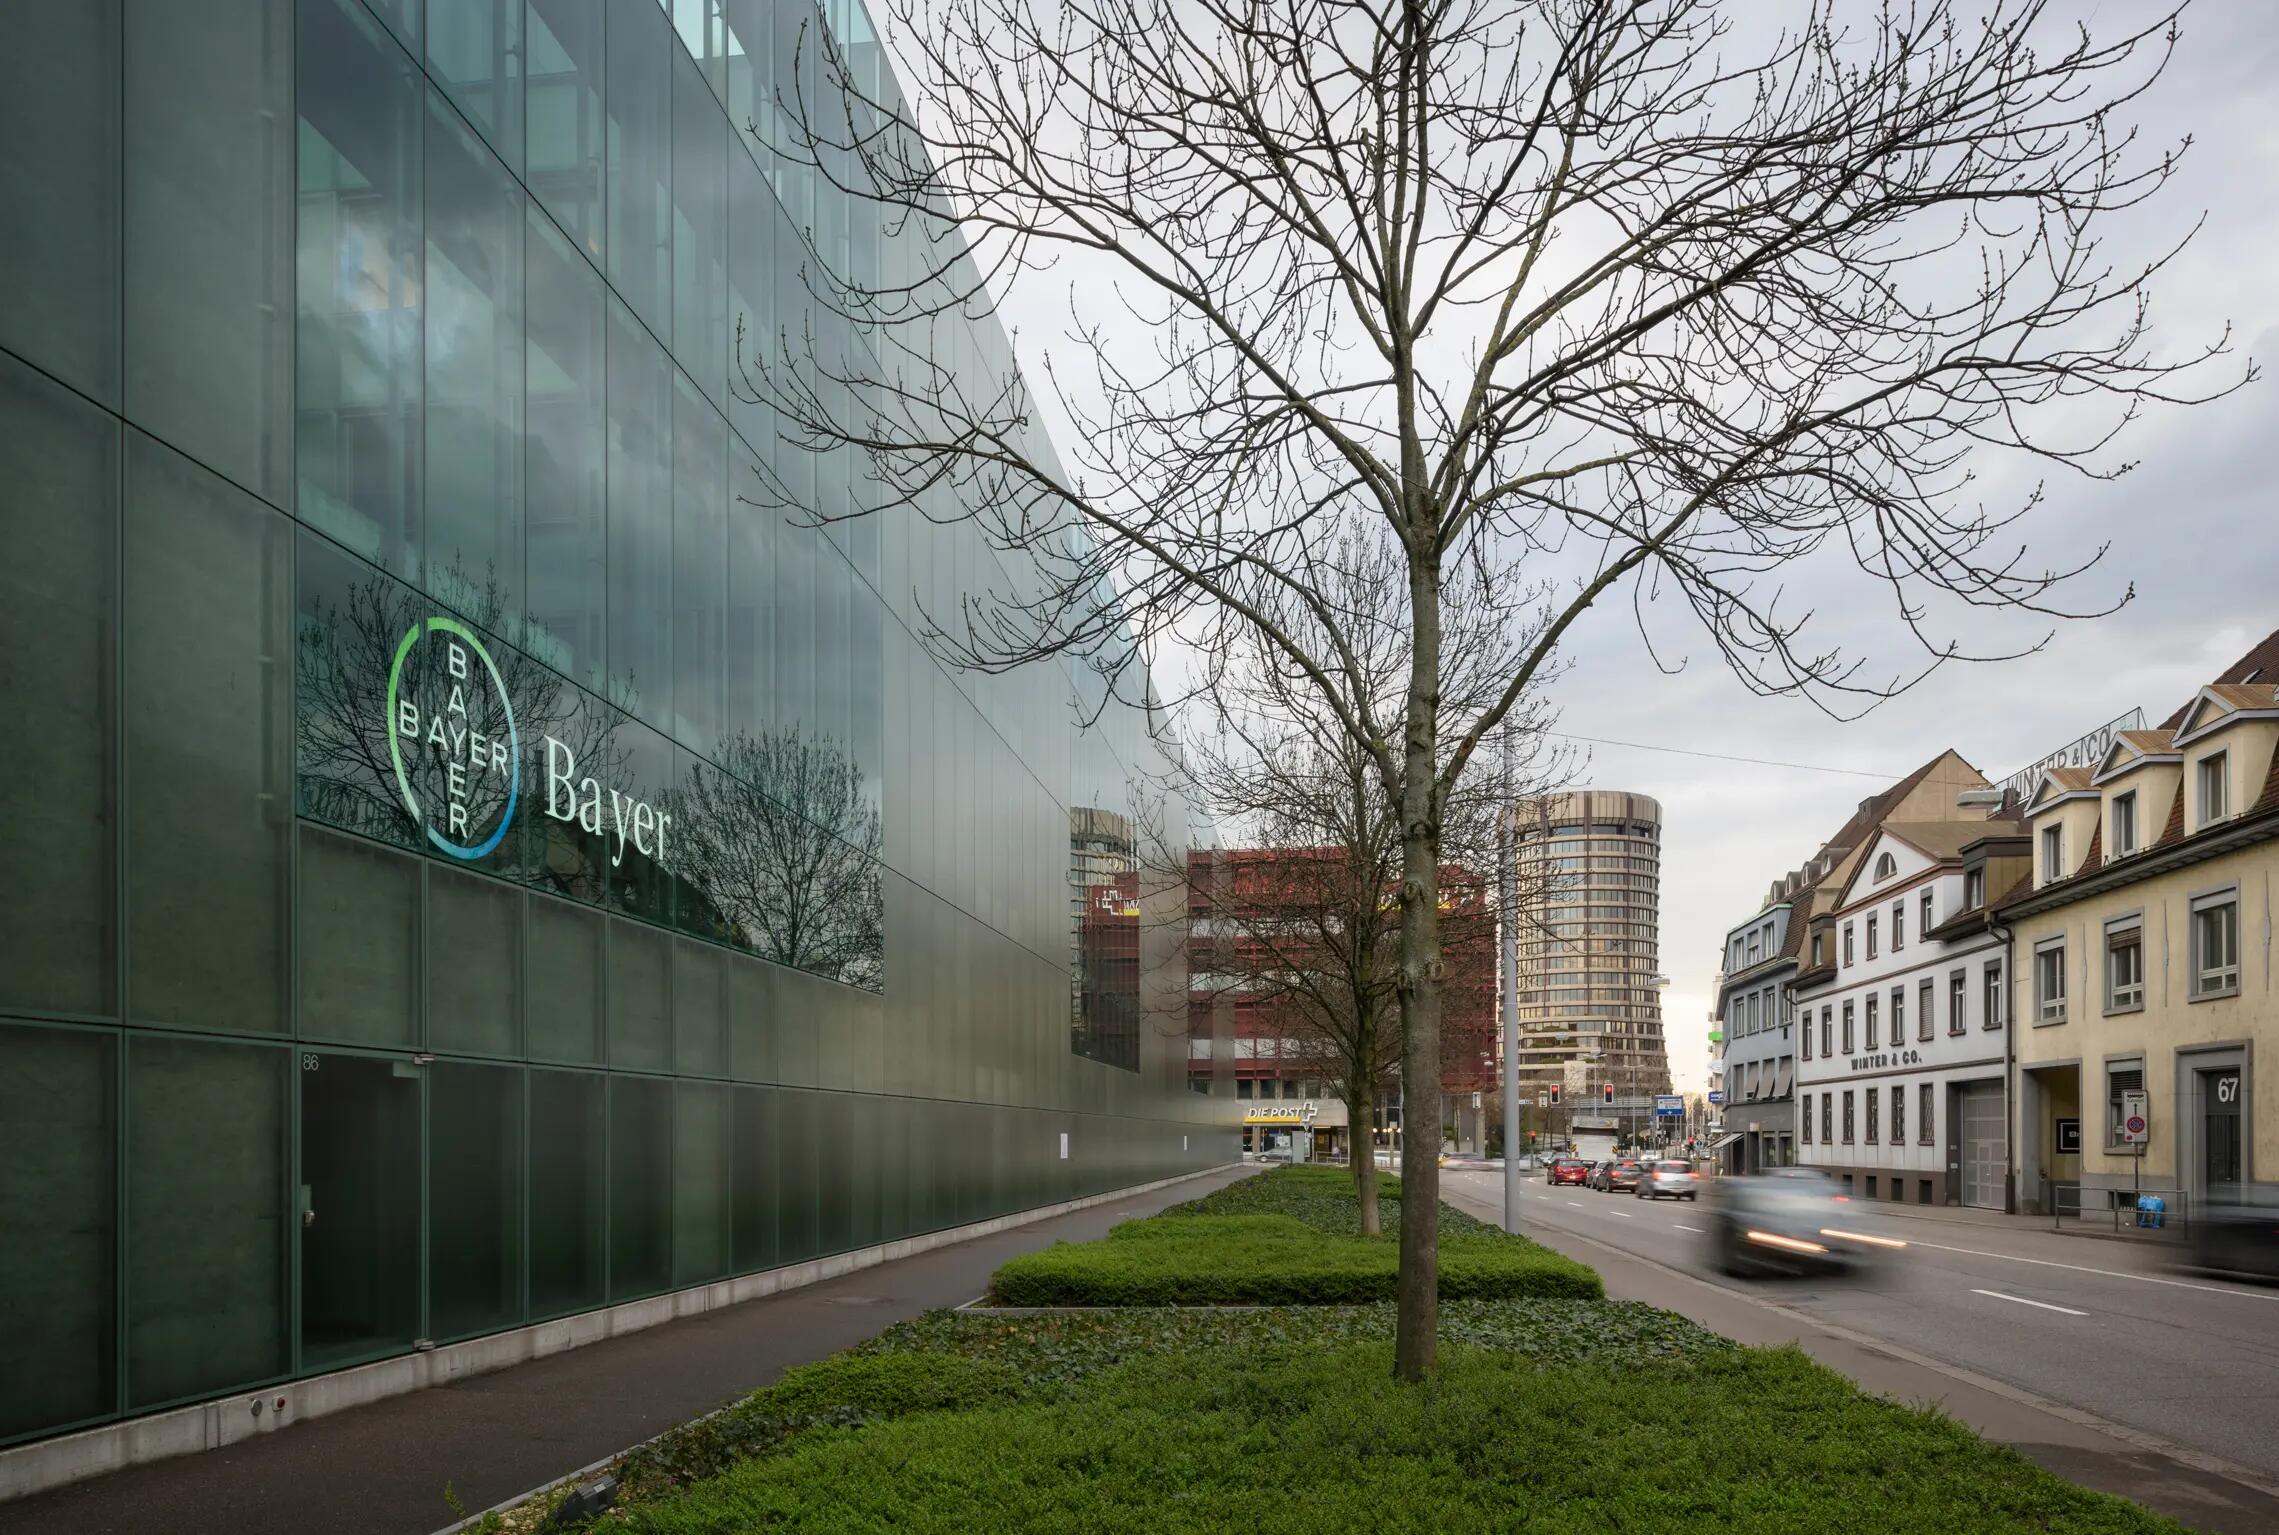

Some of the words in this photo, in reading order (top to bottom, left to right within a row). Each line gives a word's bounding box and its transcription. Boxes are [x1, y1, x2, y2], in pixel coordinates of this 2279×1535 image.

[399, 700, 508, 777] BAYER
[447, 642, 468, 838] BAYER
[544, 734, 672, 867] Bayer
[303, 1054, 319, 1071] 86
[1851, 1054, 1887, 1071] WINTER
[1902, 1050, 1922, 1065] CO.
[2218, 1077, 2239, 1103] 67
[1247, 1107, 1268, 1118] DIE
[1270, 1107, 1301, 1118] POST
